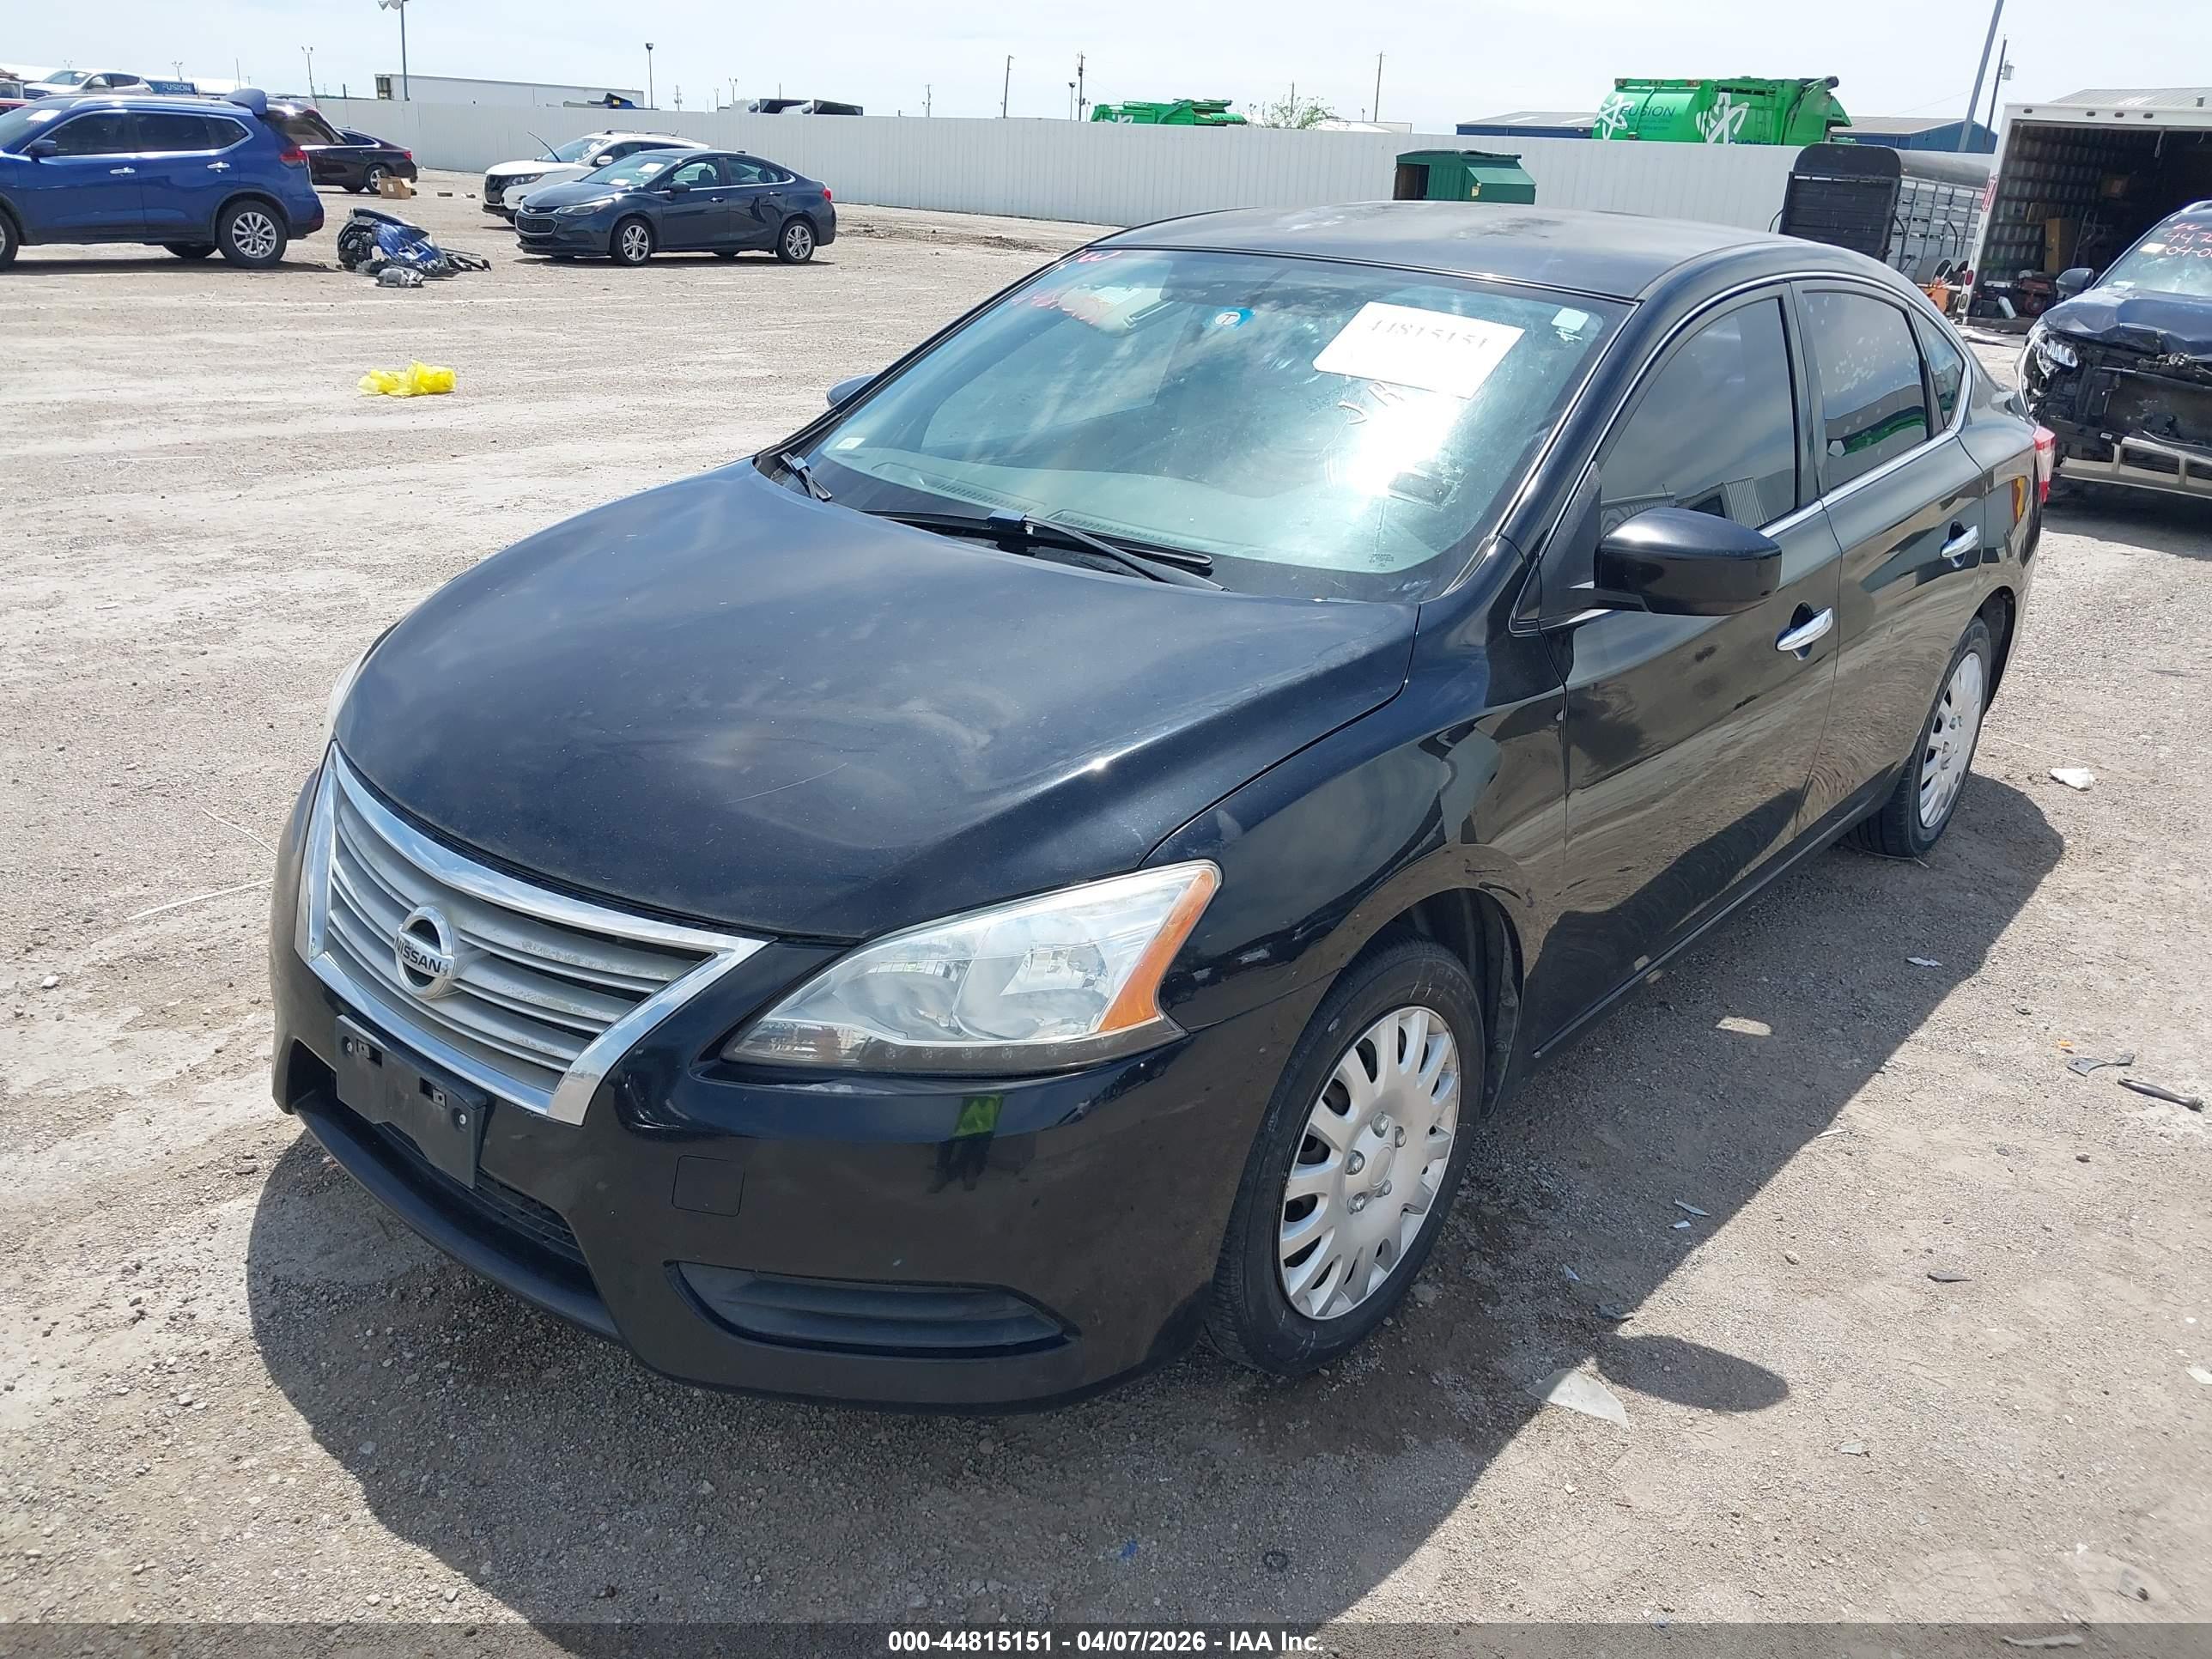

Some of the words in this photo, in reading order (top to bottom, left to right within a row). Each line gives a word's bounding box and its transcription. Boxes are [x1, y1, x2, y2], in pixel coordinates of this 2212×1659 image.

[1619, 105, 1676, 117] FUSION
[2166, 246, 2212, 258] 04-0
[393, 935, 442, 974] NISSAN
